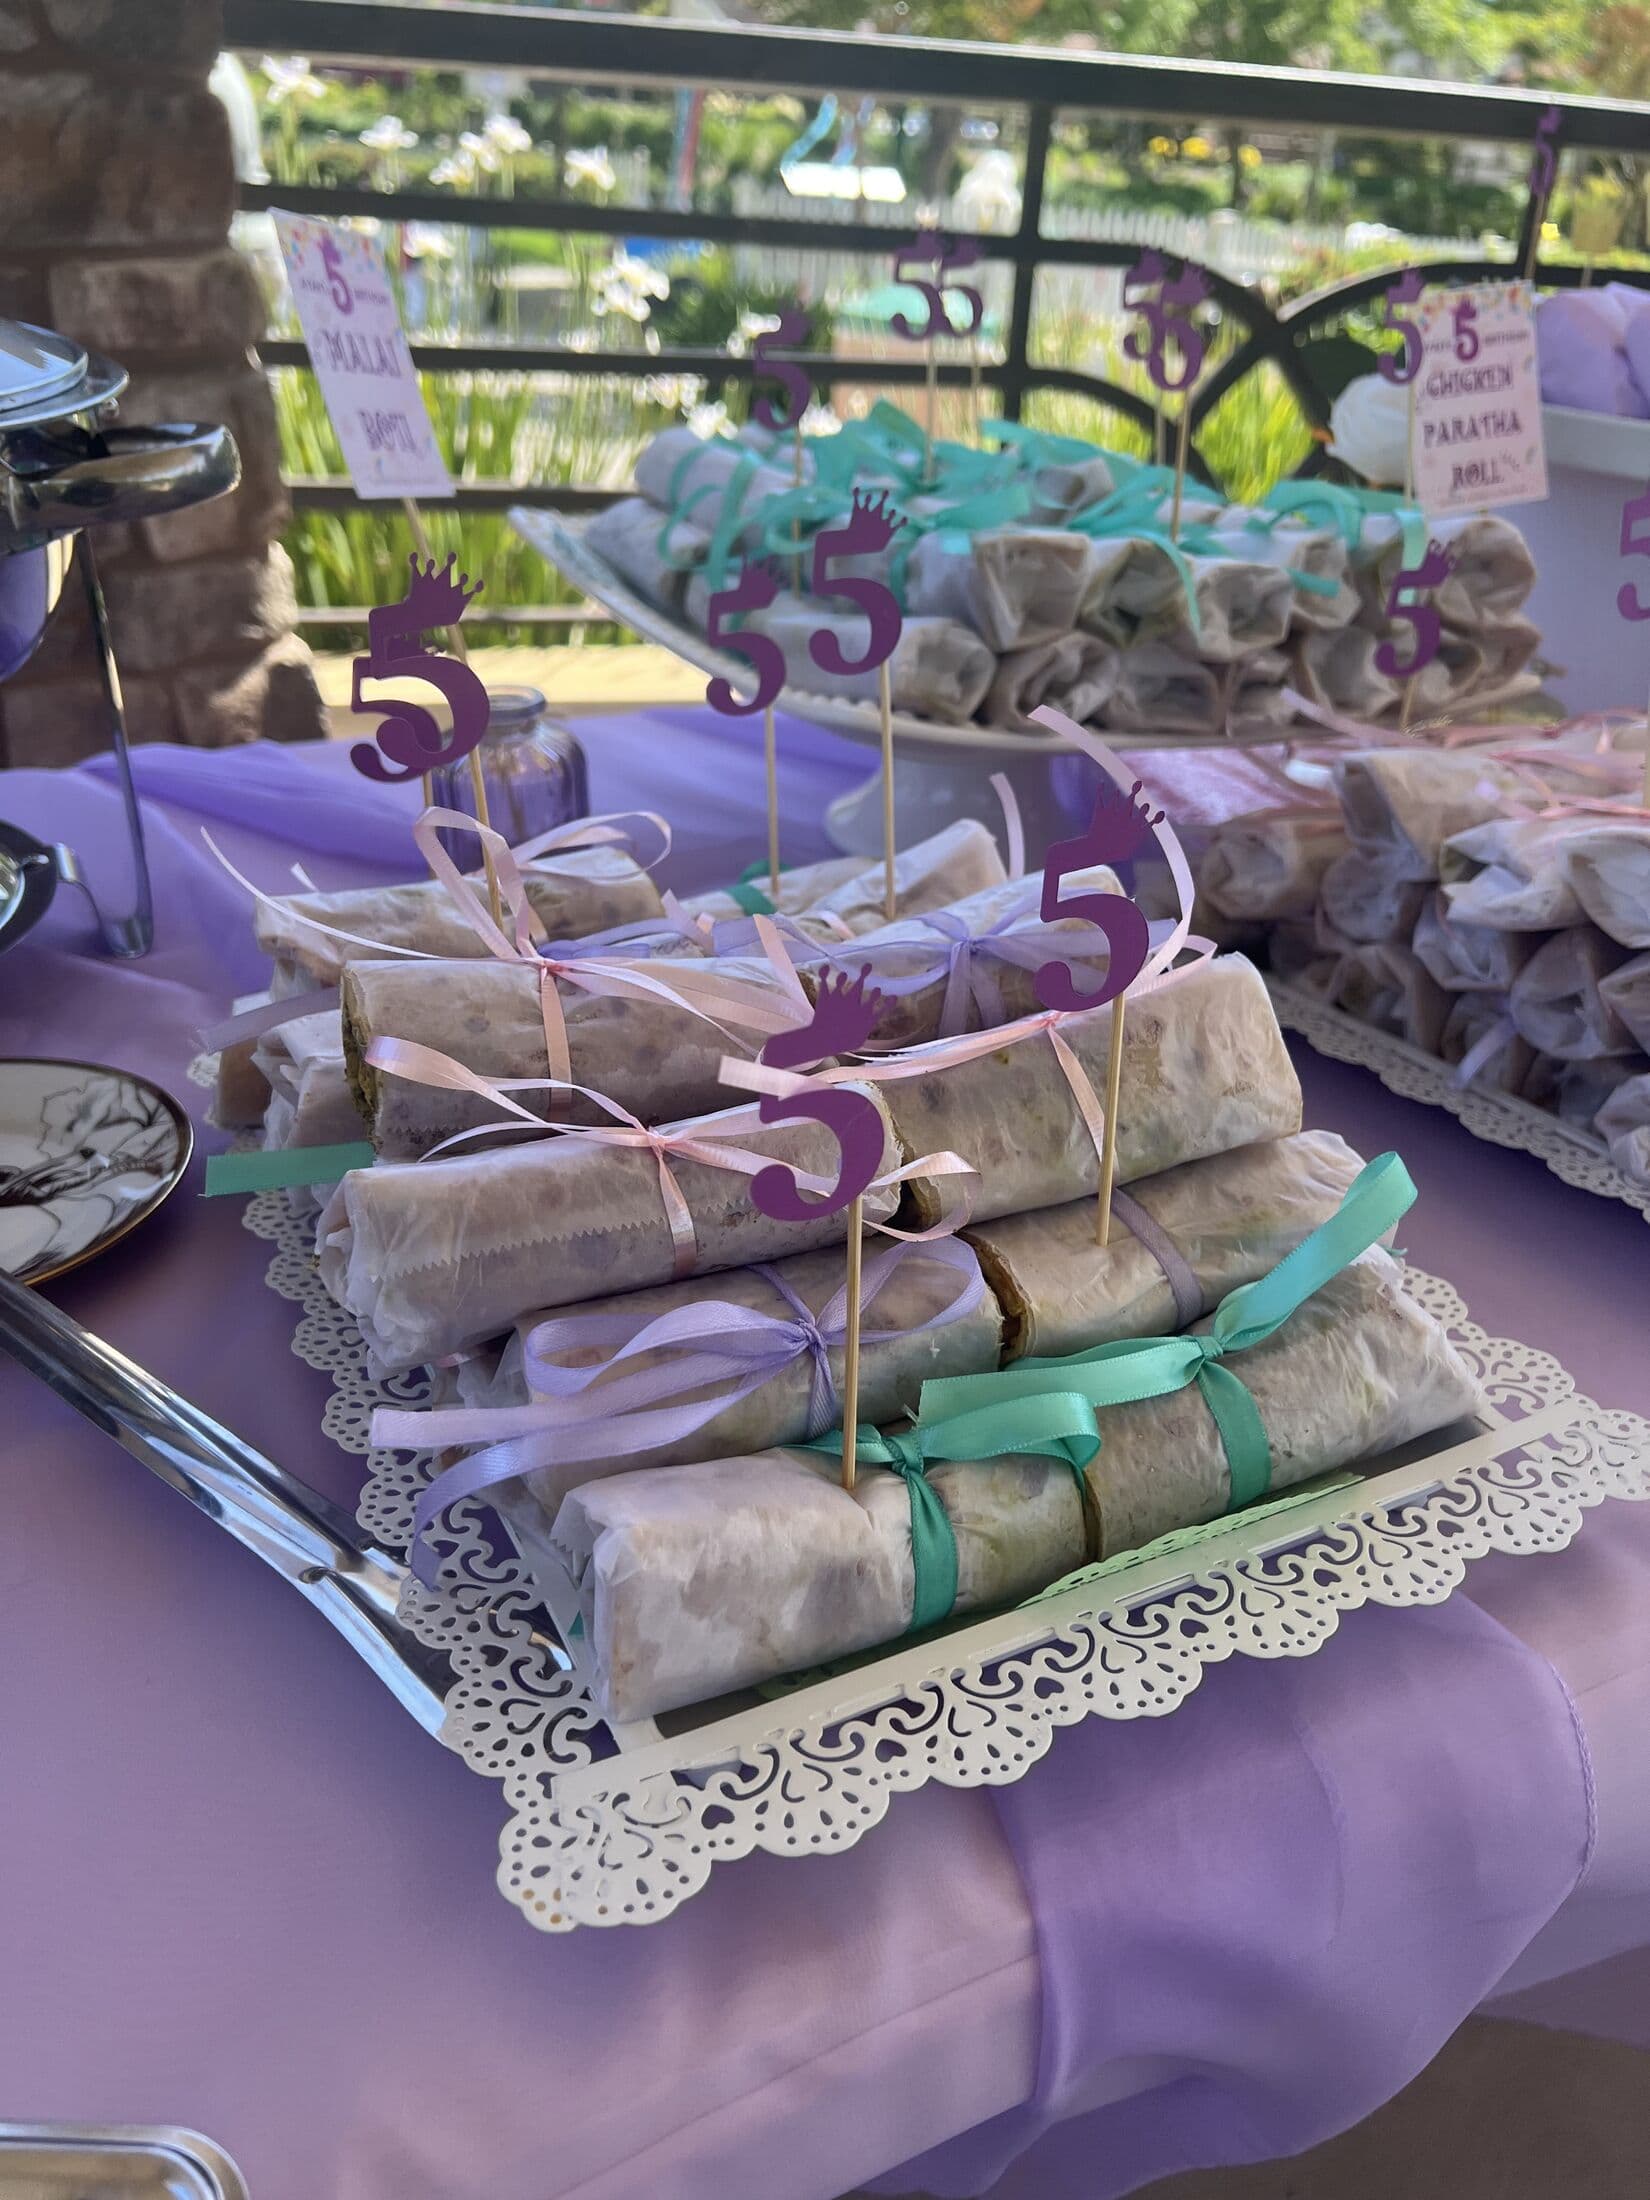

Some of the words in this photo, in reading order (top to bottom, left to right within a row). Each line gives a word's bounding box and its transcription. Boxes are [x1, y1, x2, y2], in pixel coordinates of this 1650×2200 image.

[322, 246, 354, 315] 5
[893, 247, 946, 340] 5
[321, 328, 401, 379] MALAI
[755, 325, 811, 431] 5
[1377, 284, 1424, 386] 5
[1426, 363, 1514, 399] CHICKEN
[1454, 306, 1480, 361] 5
[1422, 411, 1523, 448] PARATHA
[1452, 458, 1503, 490] ROLL
[809, 528, 902, 676] 5
[1375, 570, 1442, 678] 5
[367, 601, 491, 770] 5
[706, 592, 787, 717] 5
[1033, 838, 1150, 1013] 5
[750, 1026, 885, 1222] 5
